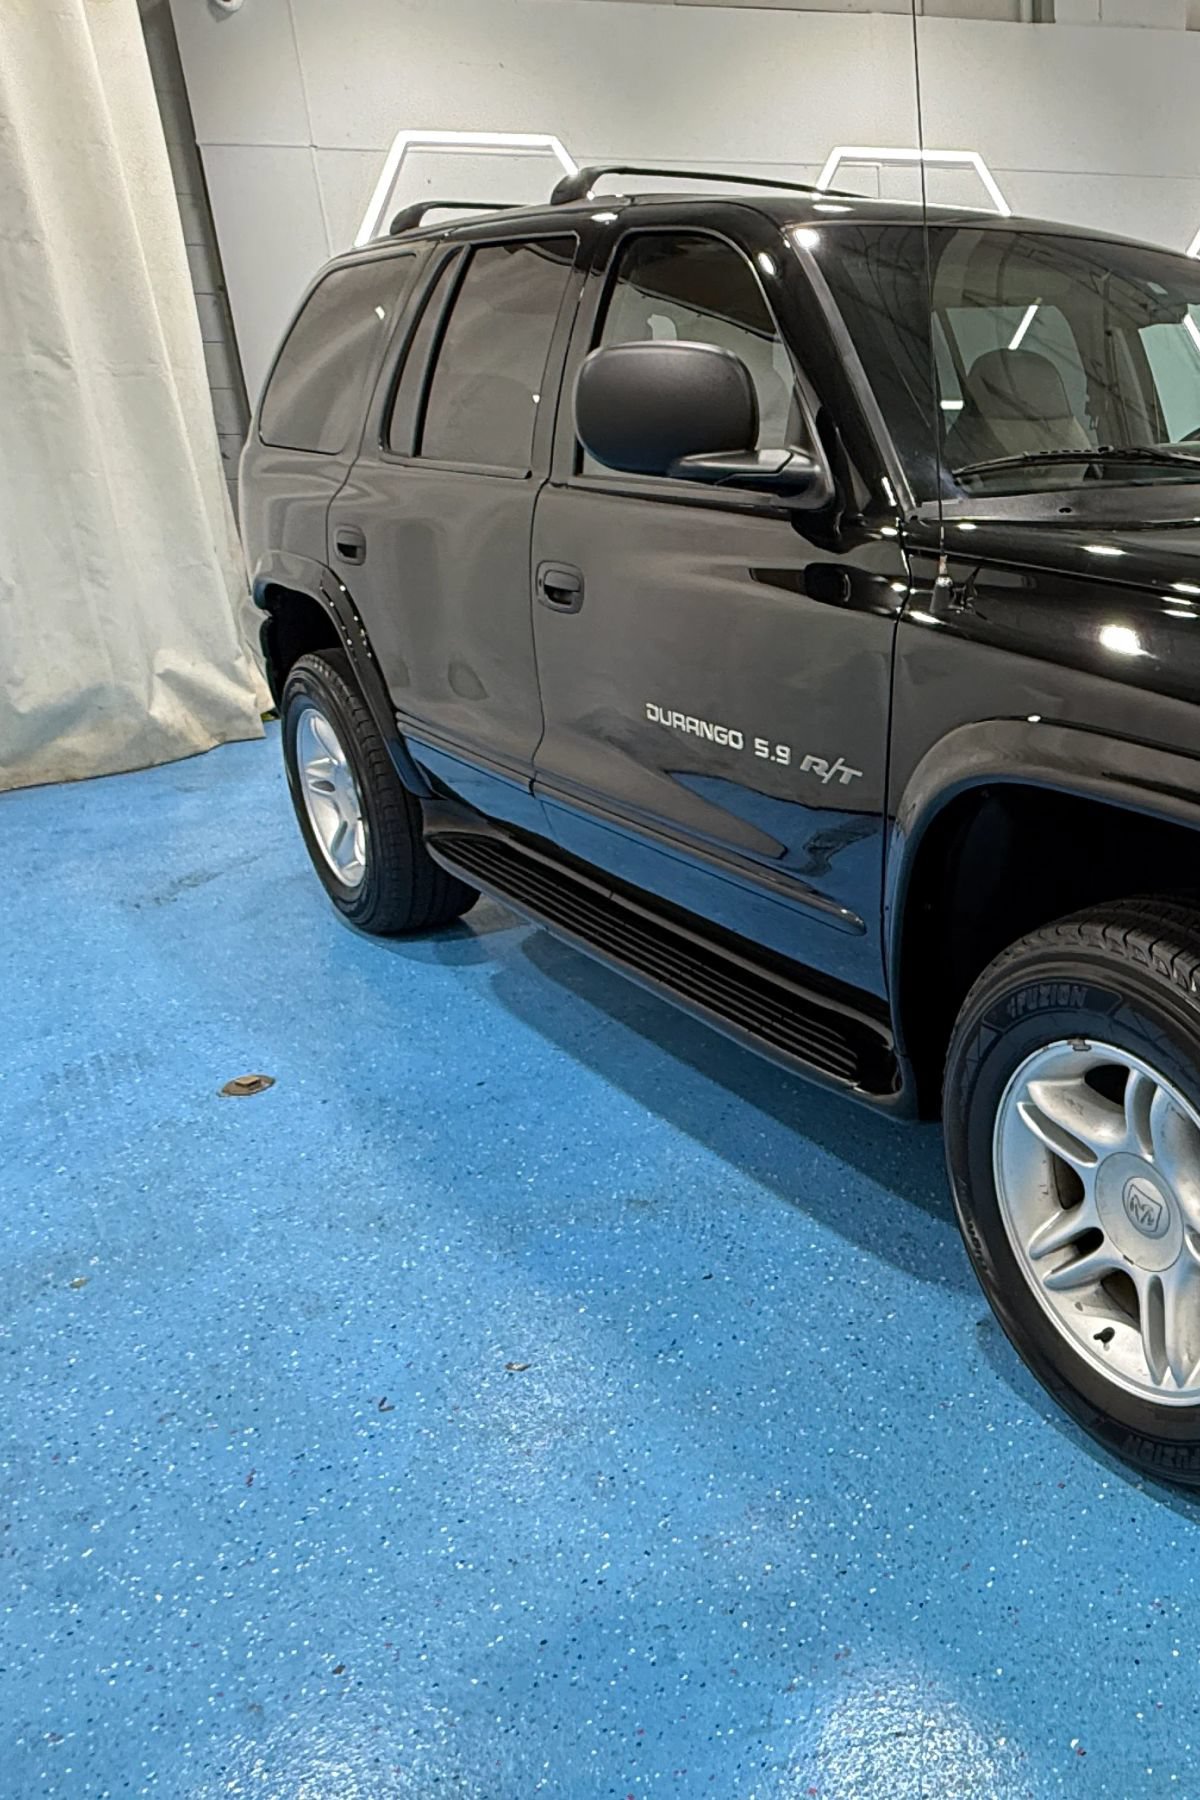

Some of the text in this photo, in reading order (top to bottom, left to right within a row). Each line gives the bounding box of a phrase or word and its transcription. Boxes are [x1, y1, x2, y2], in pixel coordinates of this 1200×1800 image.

[645, 703, 864, 785] DURANGO 5.9 R/T
